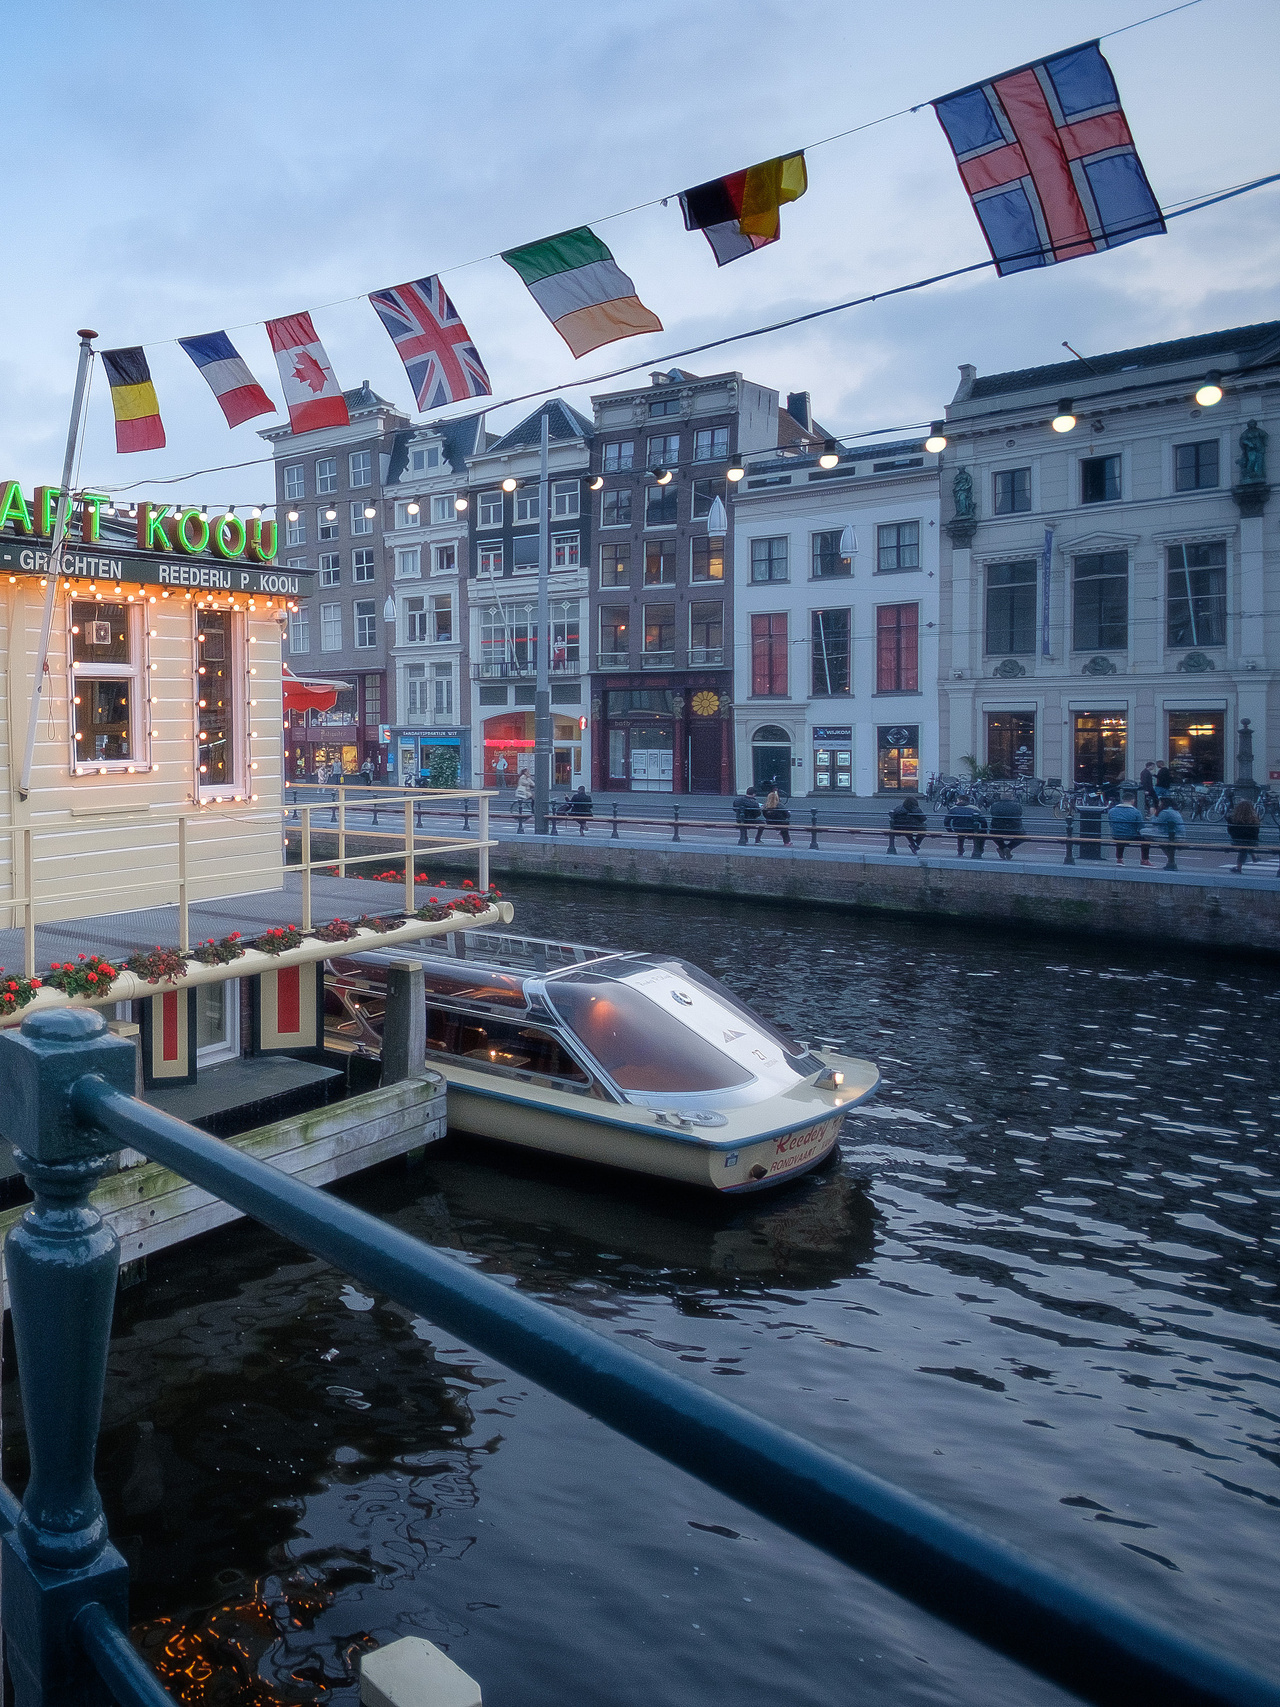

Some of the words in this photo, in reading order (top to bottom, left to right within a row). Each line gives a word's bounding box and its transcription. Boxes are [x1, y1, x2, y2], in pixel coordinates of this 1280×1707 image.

[158, 564, 231, 589] REEDERIJ
[260, 575, 299, 594] KOOIJ
[770, 1147, 816, 1171] RONDVAART
